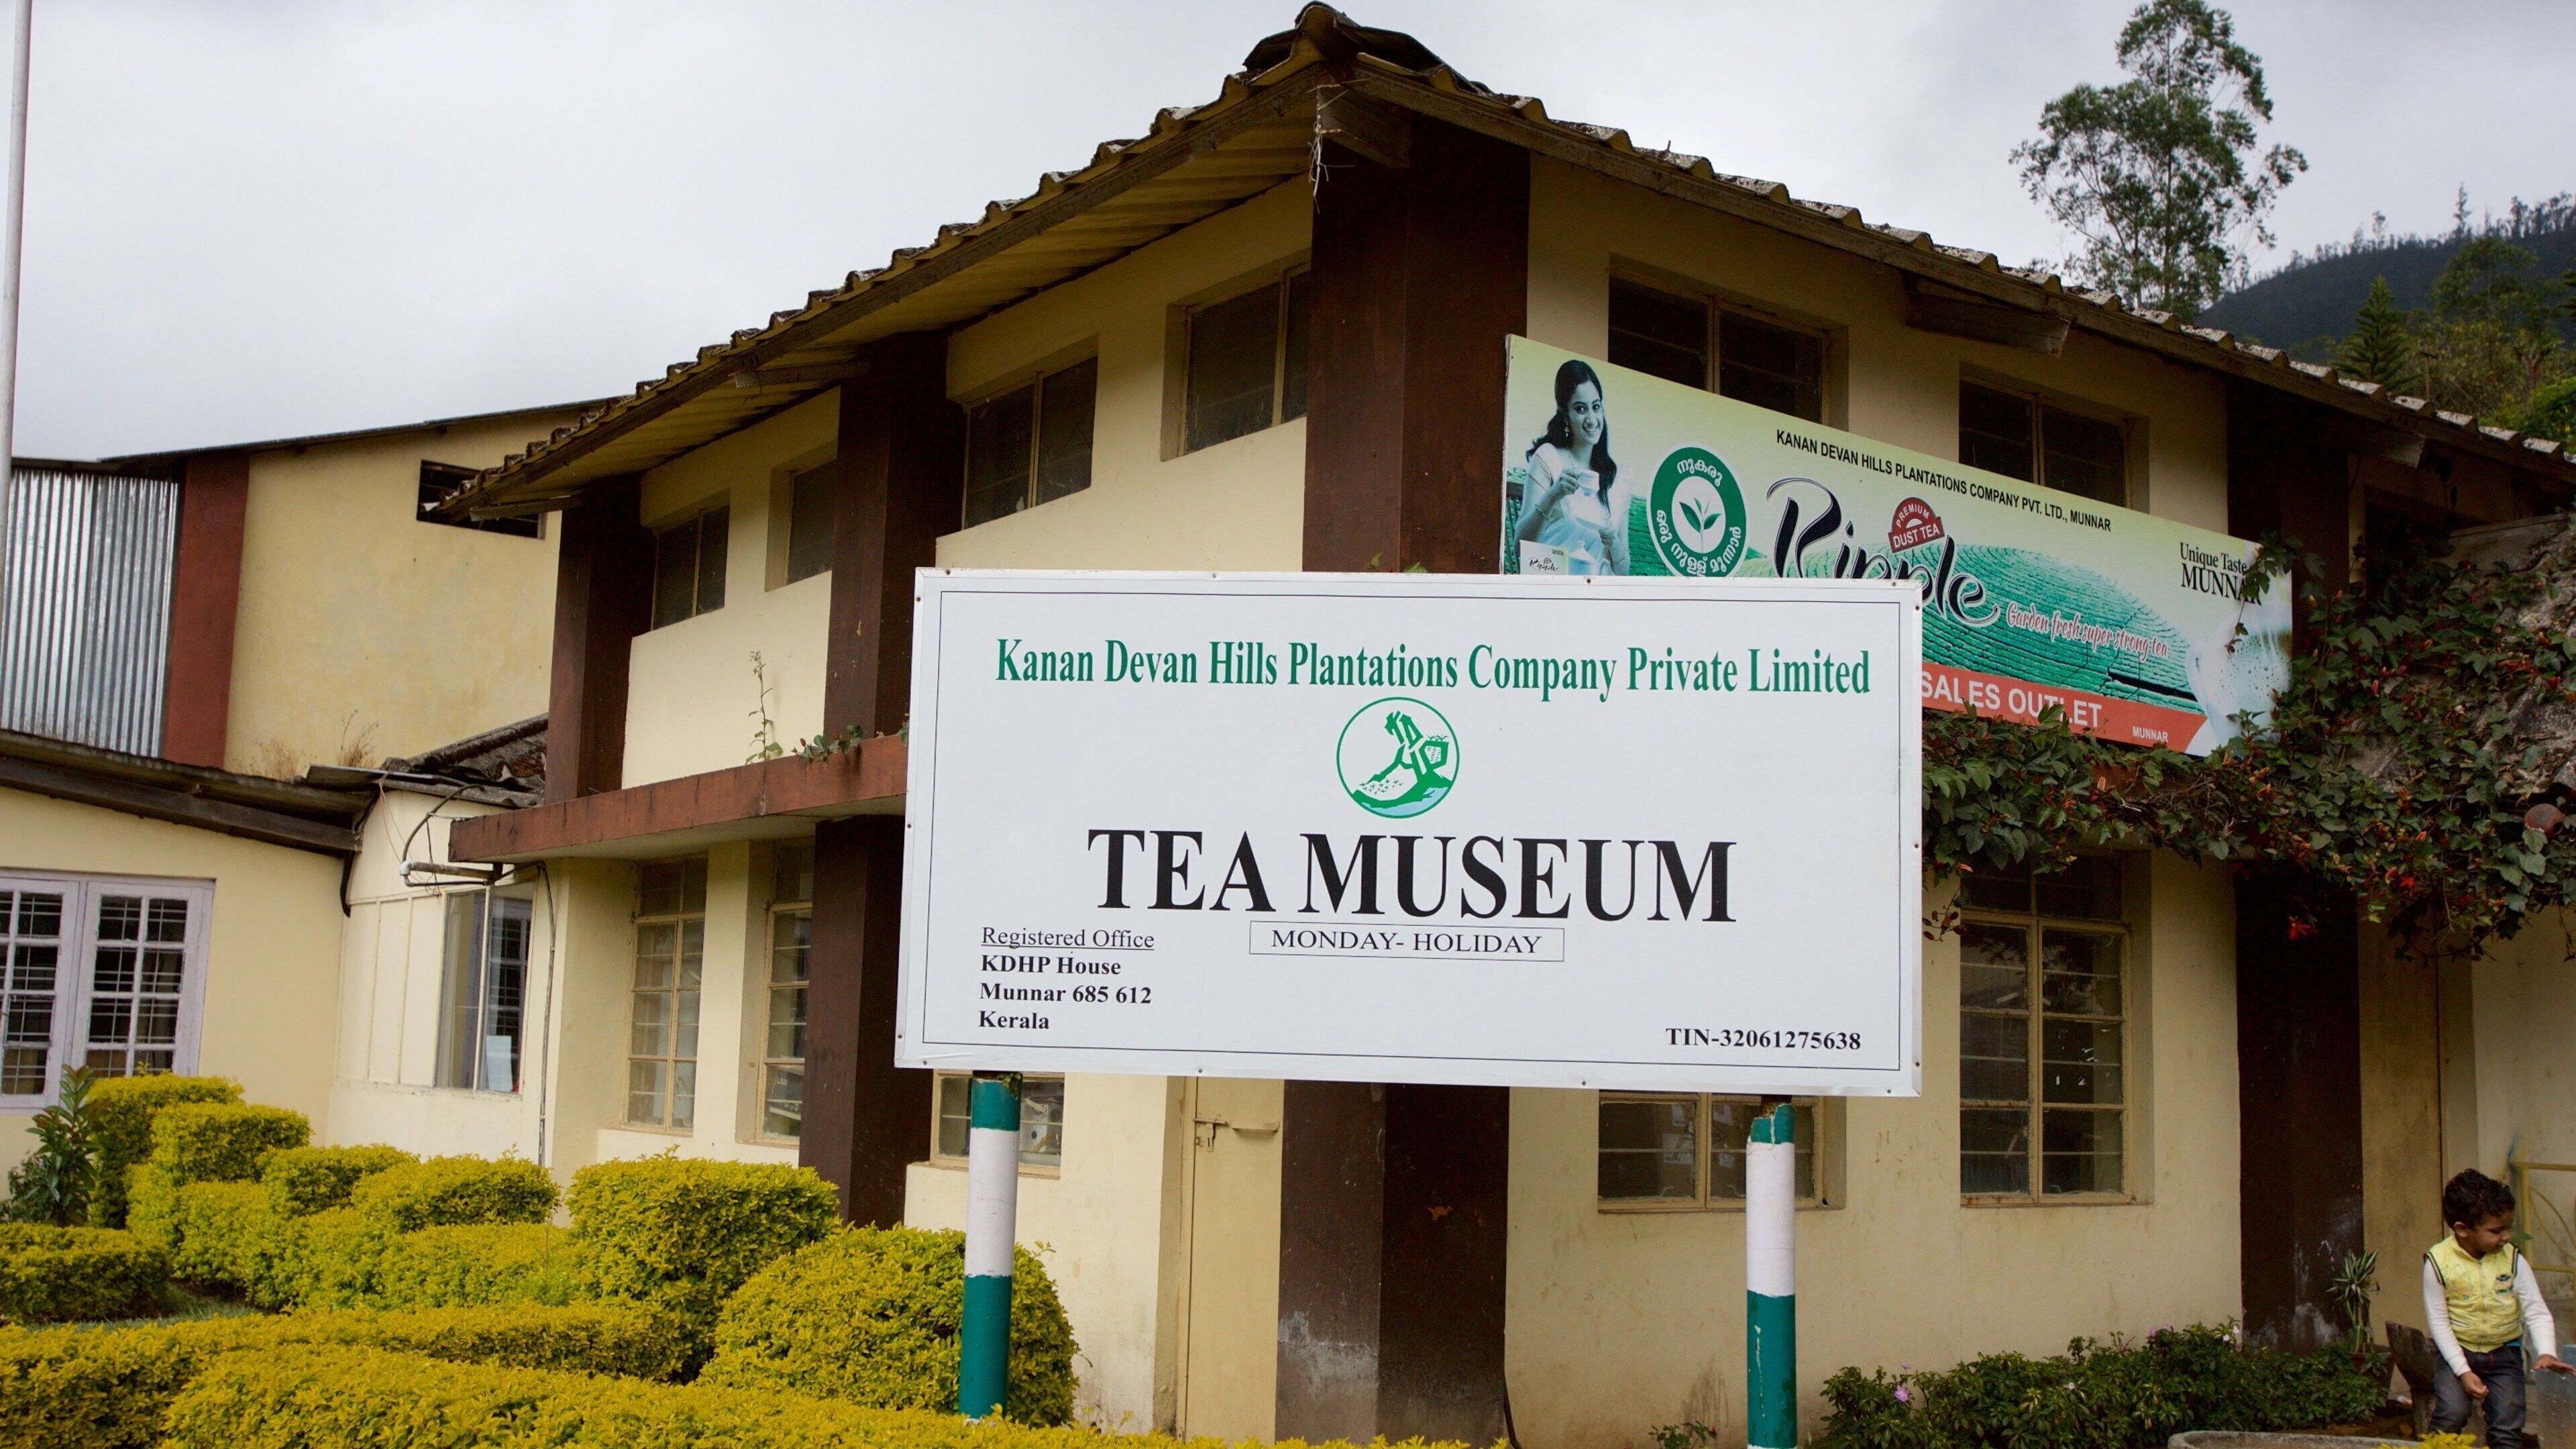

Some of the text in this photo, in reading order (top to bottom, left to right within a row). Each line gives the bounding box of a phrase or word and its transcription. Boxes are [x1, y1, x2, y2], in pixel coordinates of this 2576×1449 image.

[1776, 429, 2111, 531] KANAN DEVAN HILLS PLANTATIONS COMPANY PVT. LTD., MUNNAR
[1896, 503, 1929, 528] PREMIUM
[1893, 523, 1940, 548] DUST TEA
[2180, 541, 2247, 574] Unique Taste
[2006, 601, 2168, 661] Garden fresh super strong tea
[996, 639, 1870, 703] Kanan Devan Hills Plantations Company Private Limited
[1922, 671, 2102, 728] SALES OUTLET
[2132, 726, 2169, 743] MUNNAR
[1087, 829, 1737, 922] TEA MUSEUM
[981, 927, 1155, 949] Registered Office
[1271, 929, 1542, 954] MONDAY- HOLIDAY
[981, 955, 1121, 975] KDHP House
[979, 982, 1152, 1004] Munnar 685 612
[978, 1010, 1049, 1030] Kerala
[1666, 1027, 1862, 1051] TIN-32061275638
